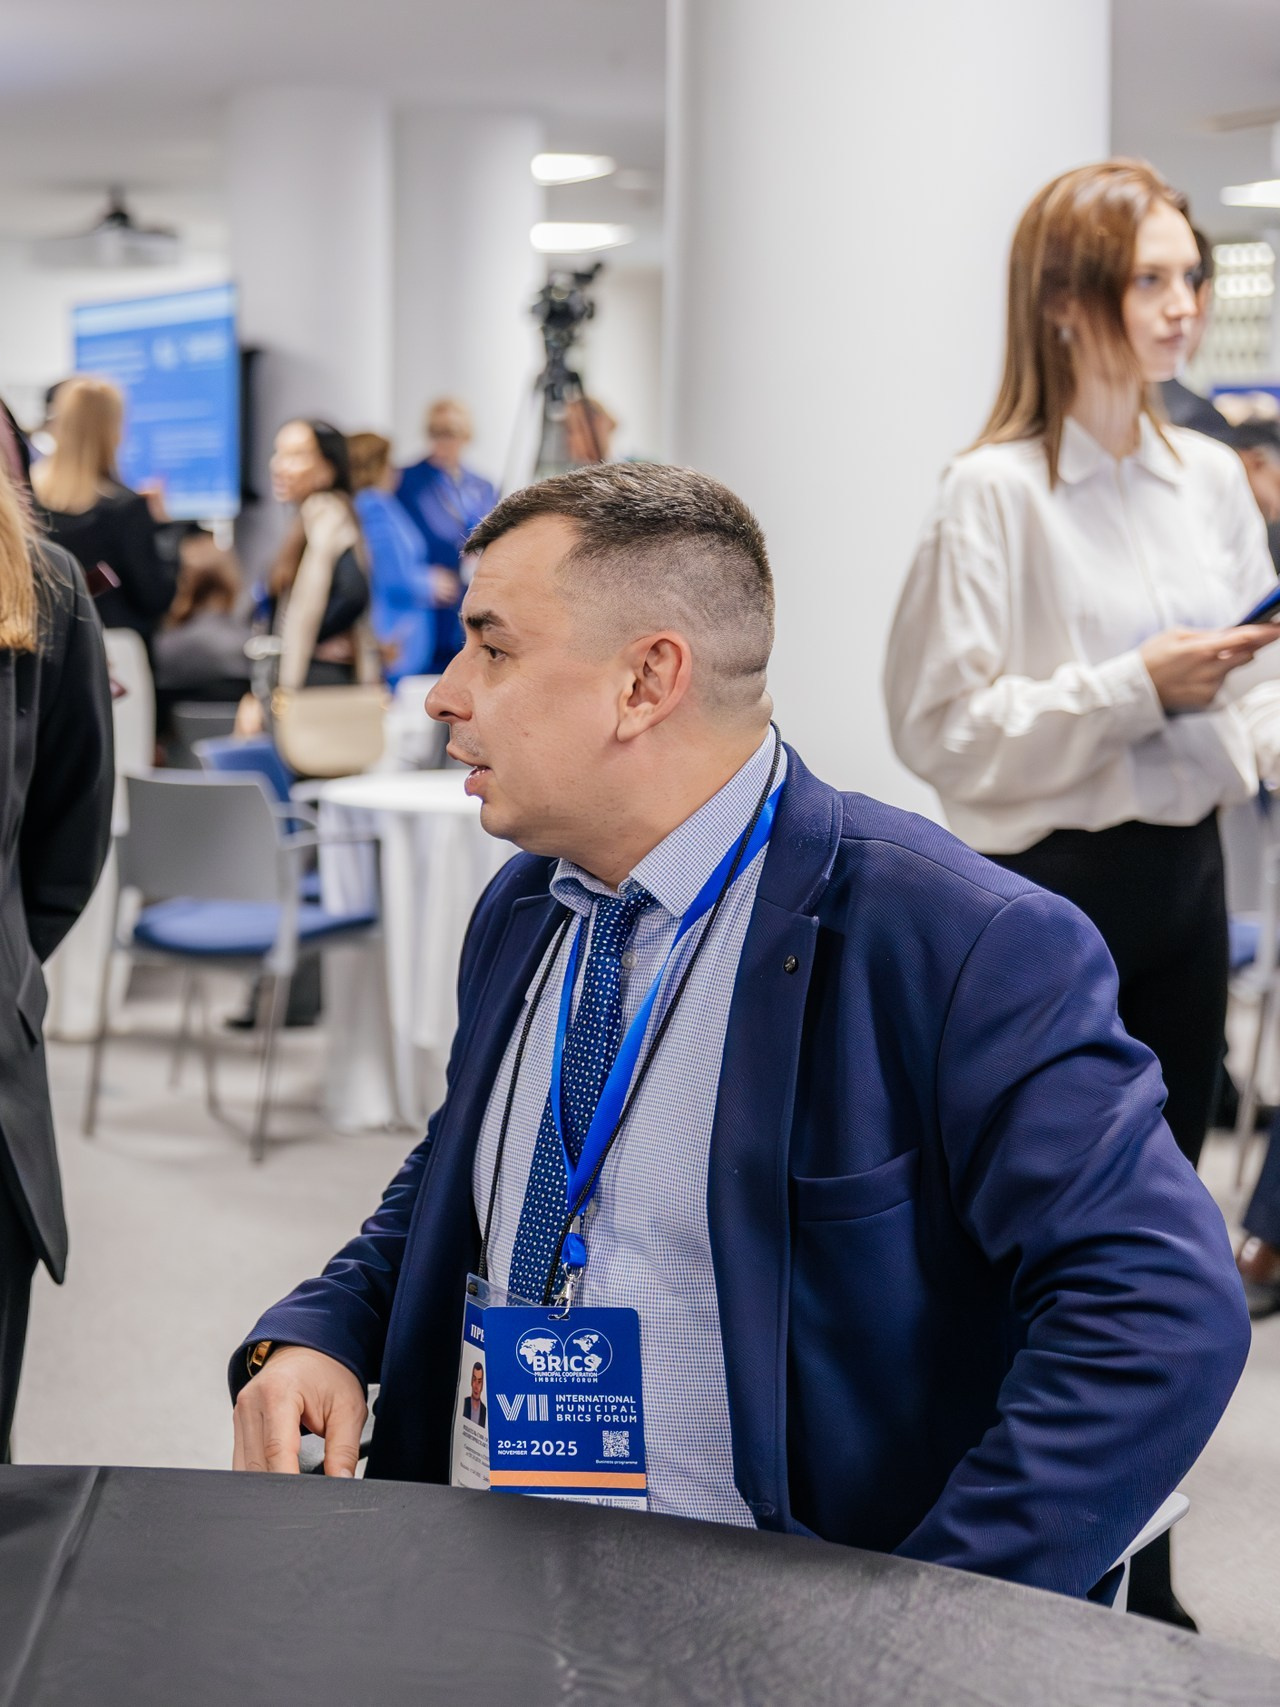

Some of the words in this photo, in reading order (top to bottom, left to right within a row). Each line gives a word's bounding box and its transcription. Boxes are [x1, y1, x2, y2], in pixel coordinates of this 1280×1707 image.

[532, 1355, 597, 1372] BRICS
[555, 1394, 637, 1404] INTERNATIONAL
[496, 1393, 549, 1421] VII
[556, 1404, 637, 1413] MUNICIPAL
[556, 1413, 591, 1422] BRICS
[596, 1414, 637, 1423] FORUM
[497, 1440, 527, 1449] 20-21
[530, 1440, 578, 1456] 2025
